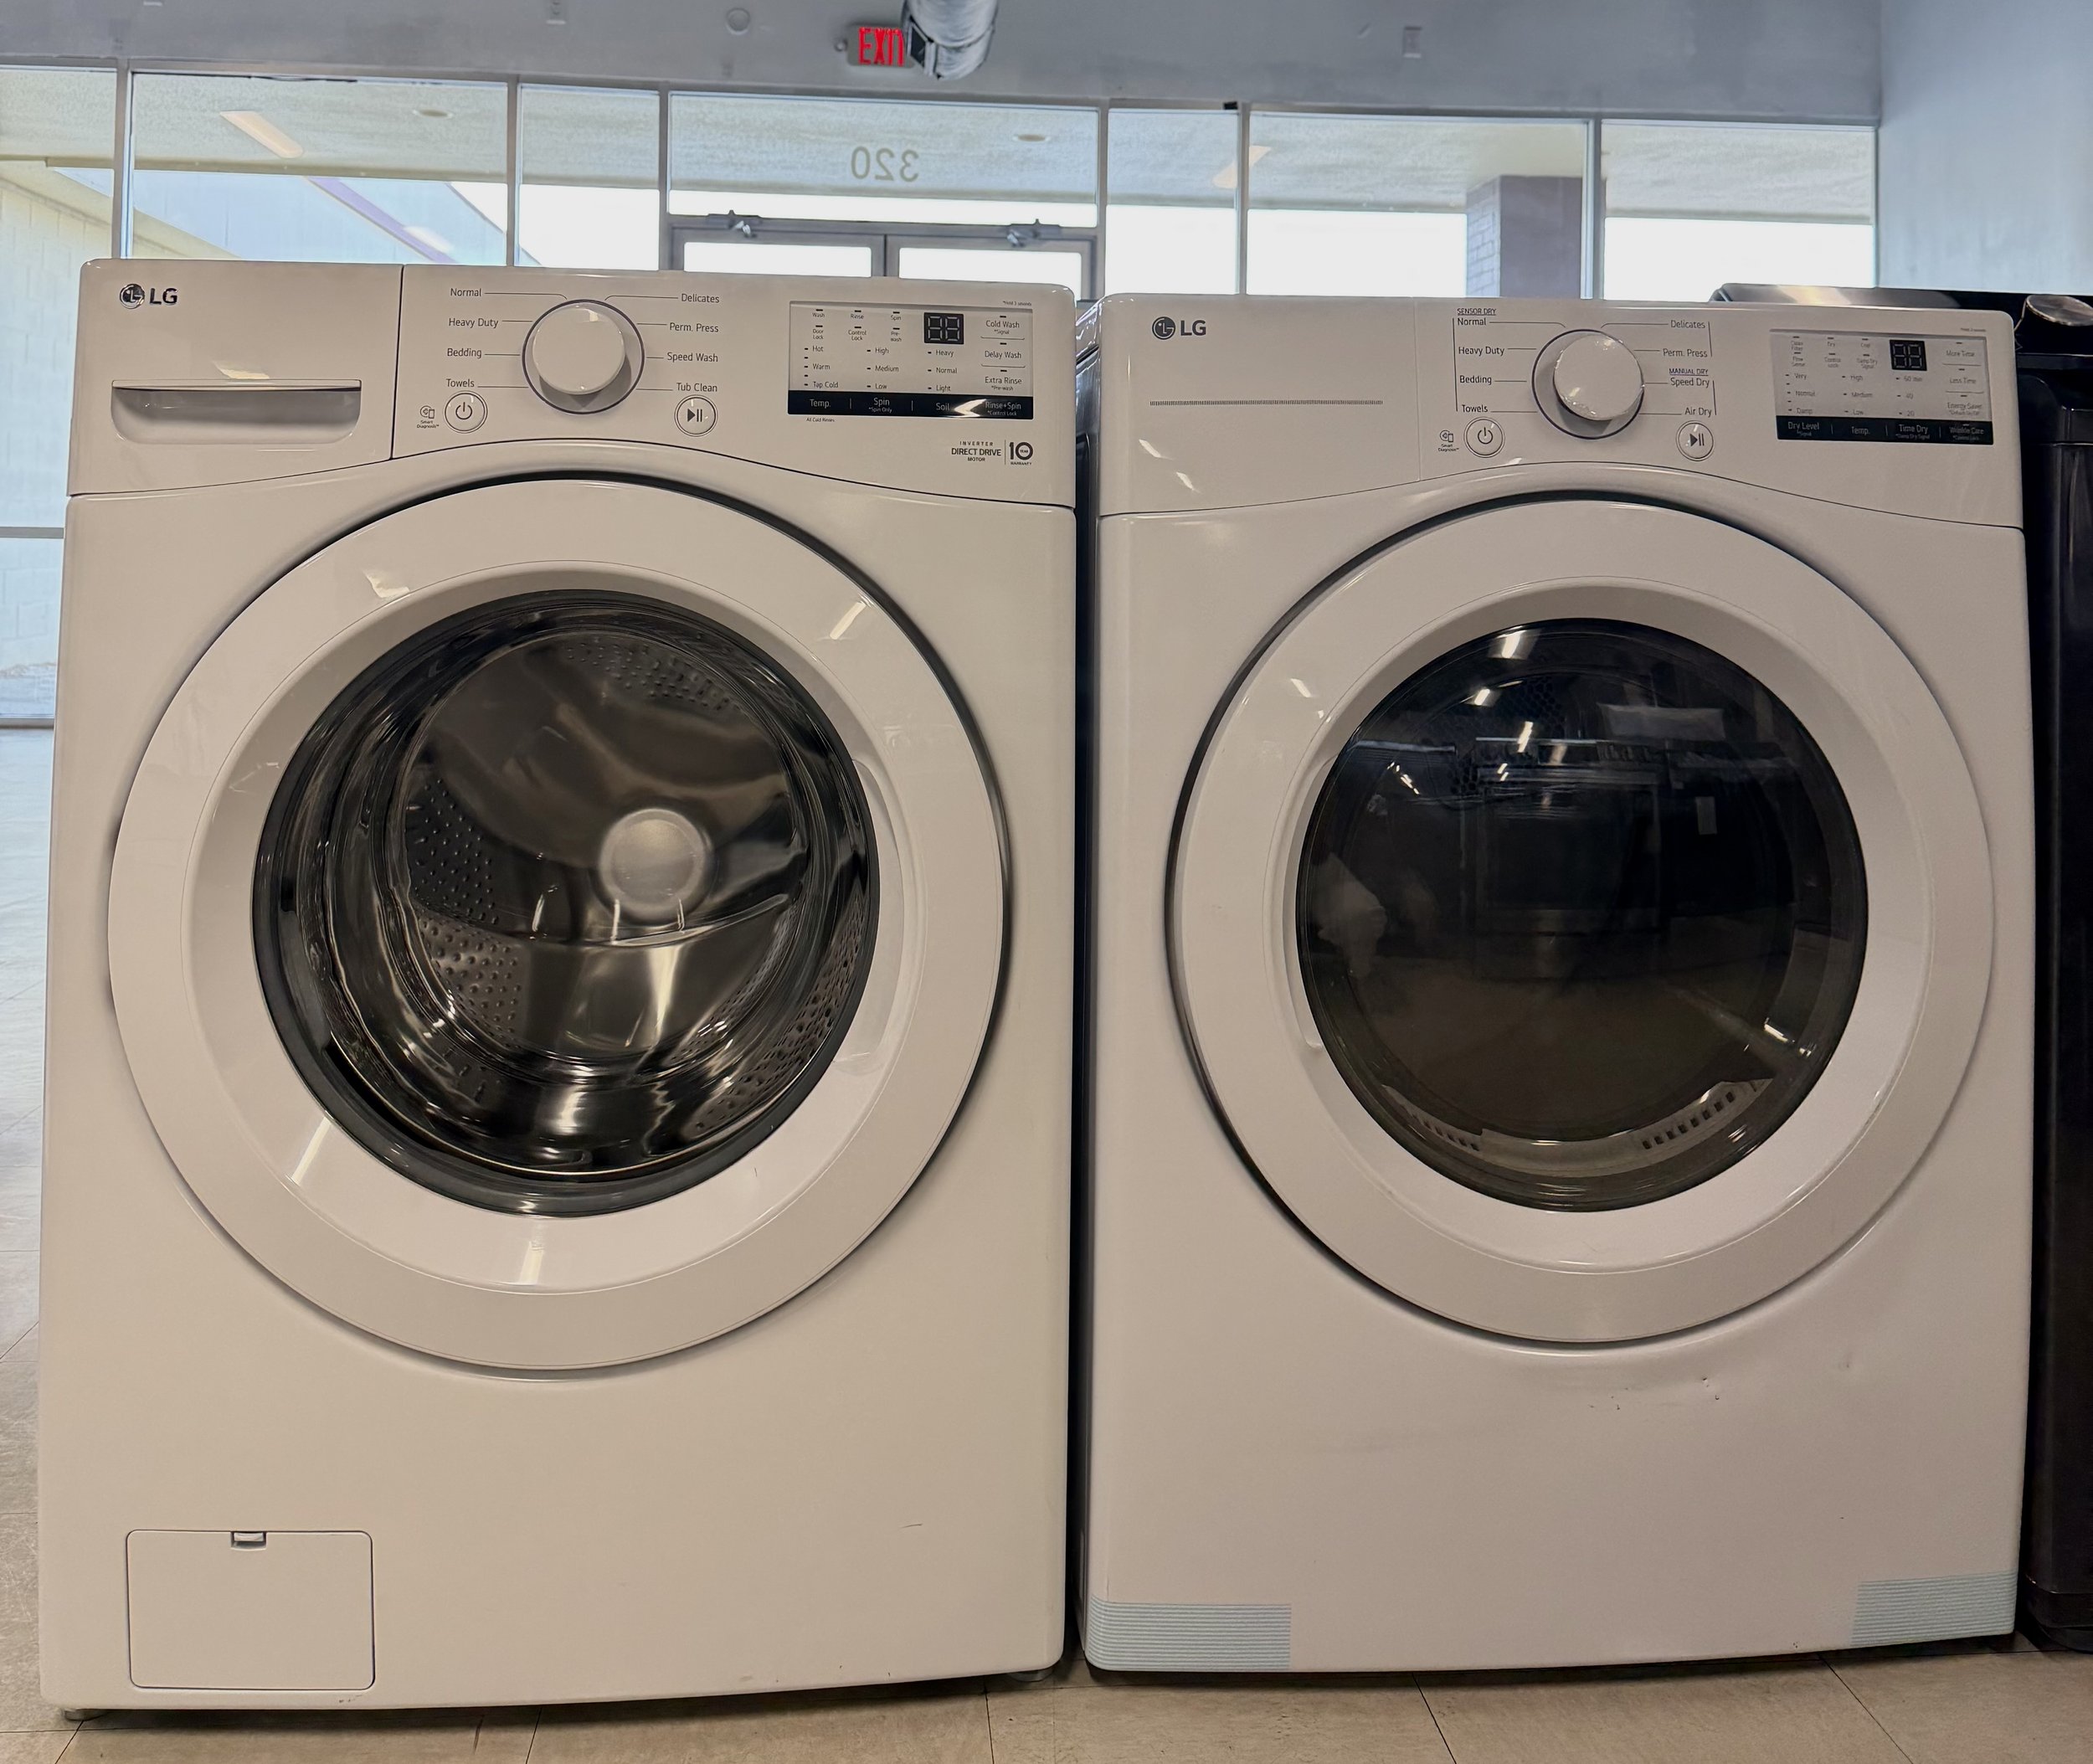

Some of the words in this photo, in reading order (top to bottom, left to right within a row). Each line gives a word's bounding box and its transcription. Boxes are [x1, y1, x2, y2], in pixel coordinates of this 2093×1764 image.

[150, 288, 177, 305] LG
[450, 288, 482, 297] Normal
[681, 294, 720, 303] Delicates
[449, 318, 476, 328] Heavy
[478, 318, 499, 328] Duty
[670, 322, 693, 332] Perm.
[696, 323, 719, 332] Press
[1180, 320, 1206, 336] LG
[1670, 320, 1706, 329] Delicates
[447, 348, 482, 359] Bedding
[935, 349, 954, 357] Heavy
[985, 351, 1003, 360] Delay
[1005, 351, 1022, 359] Wash
[1458, 347, 1483, 357] Heavy
[1485, 347, 1505, 357] Duty
[1663, 348, 1684, 357] Perm.
[1687, 349, 1708, 357] Press
[667, 352, 693, 363] Speed
[696, 353, 718, 363] Wash
[446, 378, 475, 388] Towels
[1459, 375, 1492, 385] Bedding
[1670, 378, 1694, 388] Speed
[1696, 378, 1710, 388] Dry
[676, 383, 691, 392] Tub
[694, 383, 717, 392] Clean
[810, 399, 831, 409] Temp.
[873, 398, 890, 407] Spin
[935, 403, 950, 411] Soil
[1462, 404, 1489, 413] Towels
[1698, 408, 1712, 418] Dry
[1787, 422, 1800, 430] Dry
[1802, 422, 1820, 430] Level
[1851, 426, 1870, 435] Temp.
[1899, 424, 1916, 432] Time
[1916, 424, 1928, 434] Dry
